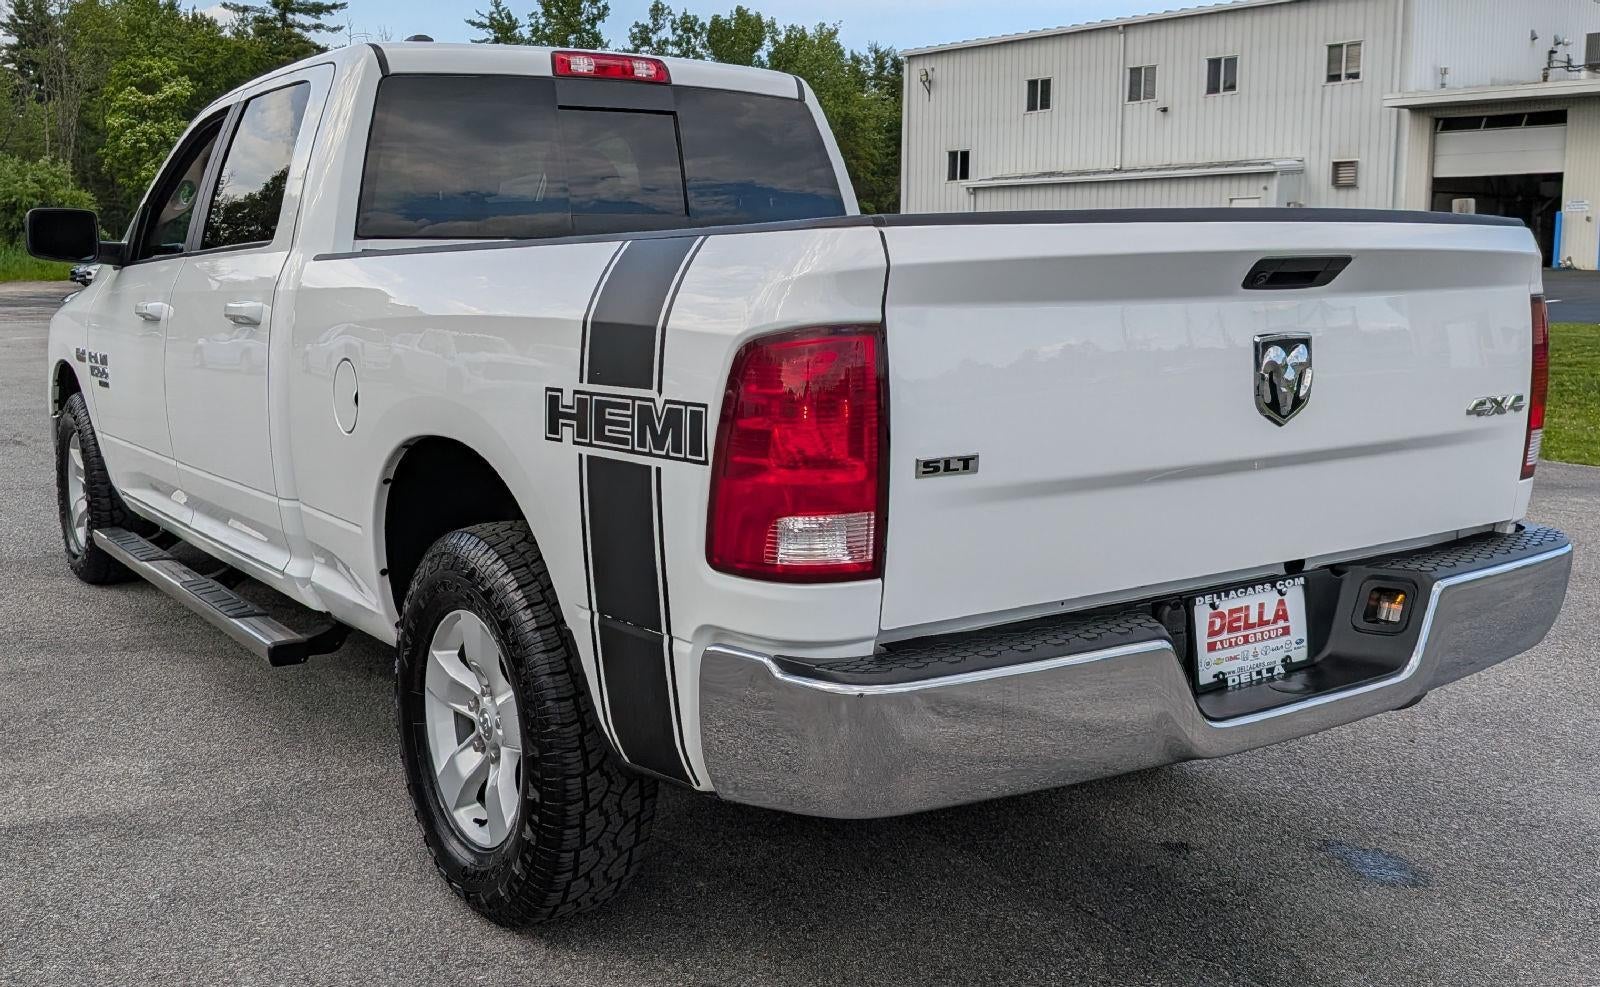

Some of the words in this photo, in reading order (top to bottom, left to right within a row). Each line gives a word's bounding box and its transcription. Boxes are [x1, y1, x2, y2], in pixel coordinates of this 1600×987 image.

[545, 387, 709, 466] HEMI
[920, 456, 977, 475] SLT
[1195, 577, 1305, 606] DELLACARS.COM
[1207, 598, 1290, 639] DELLA
[1215, 636, 1244, 650] AUTO
[1248, 628, 1284, 643] GROUP
[1228, 665, 1286, 687] DELLA
